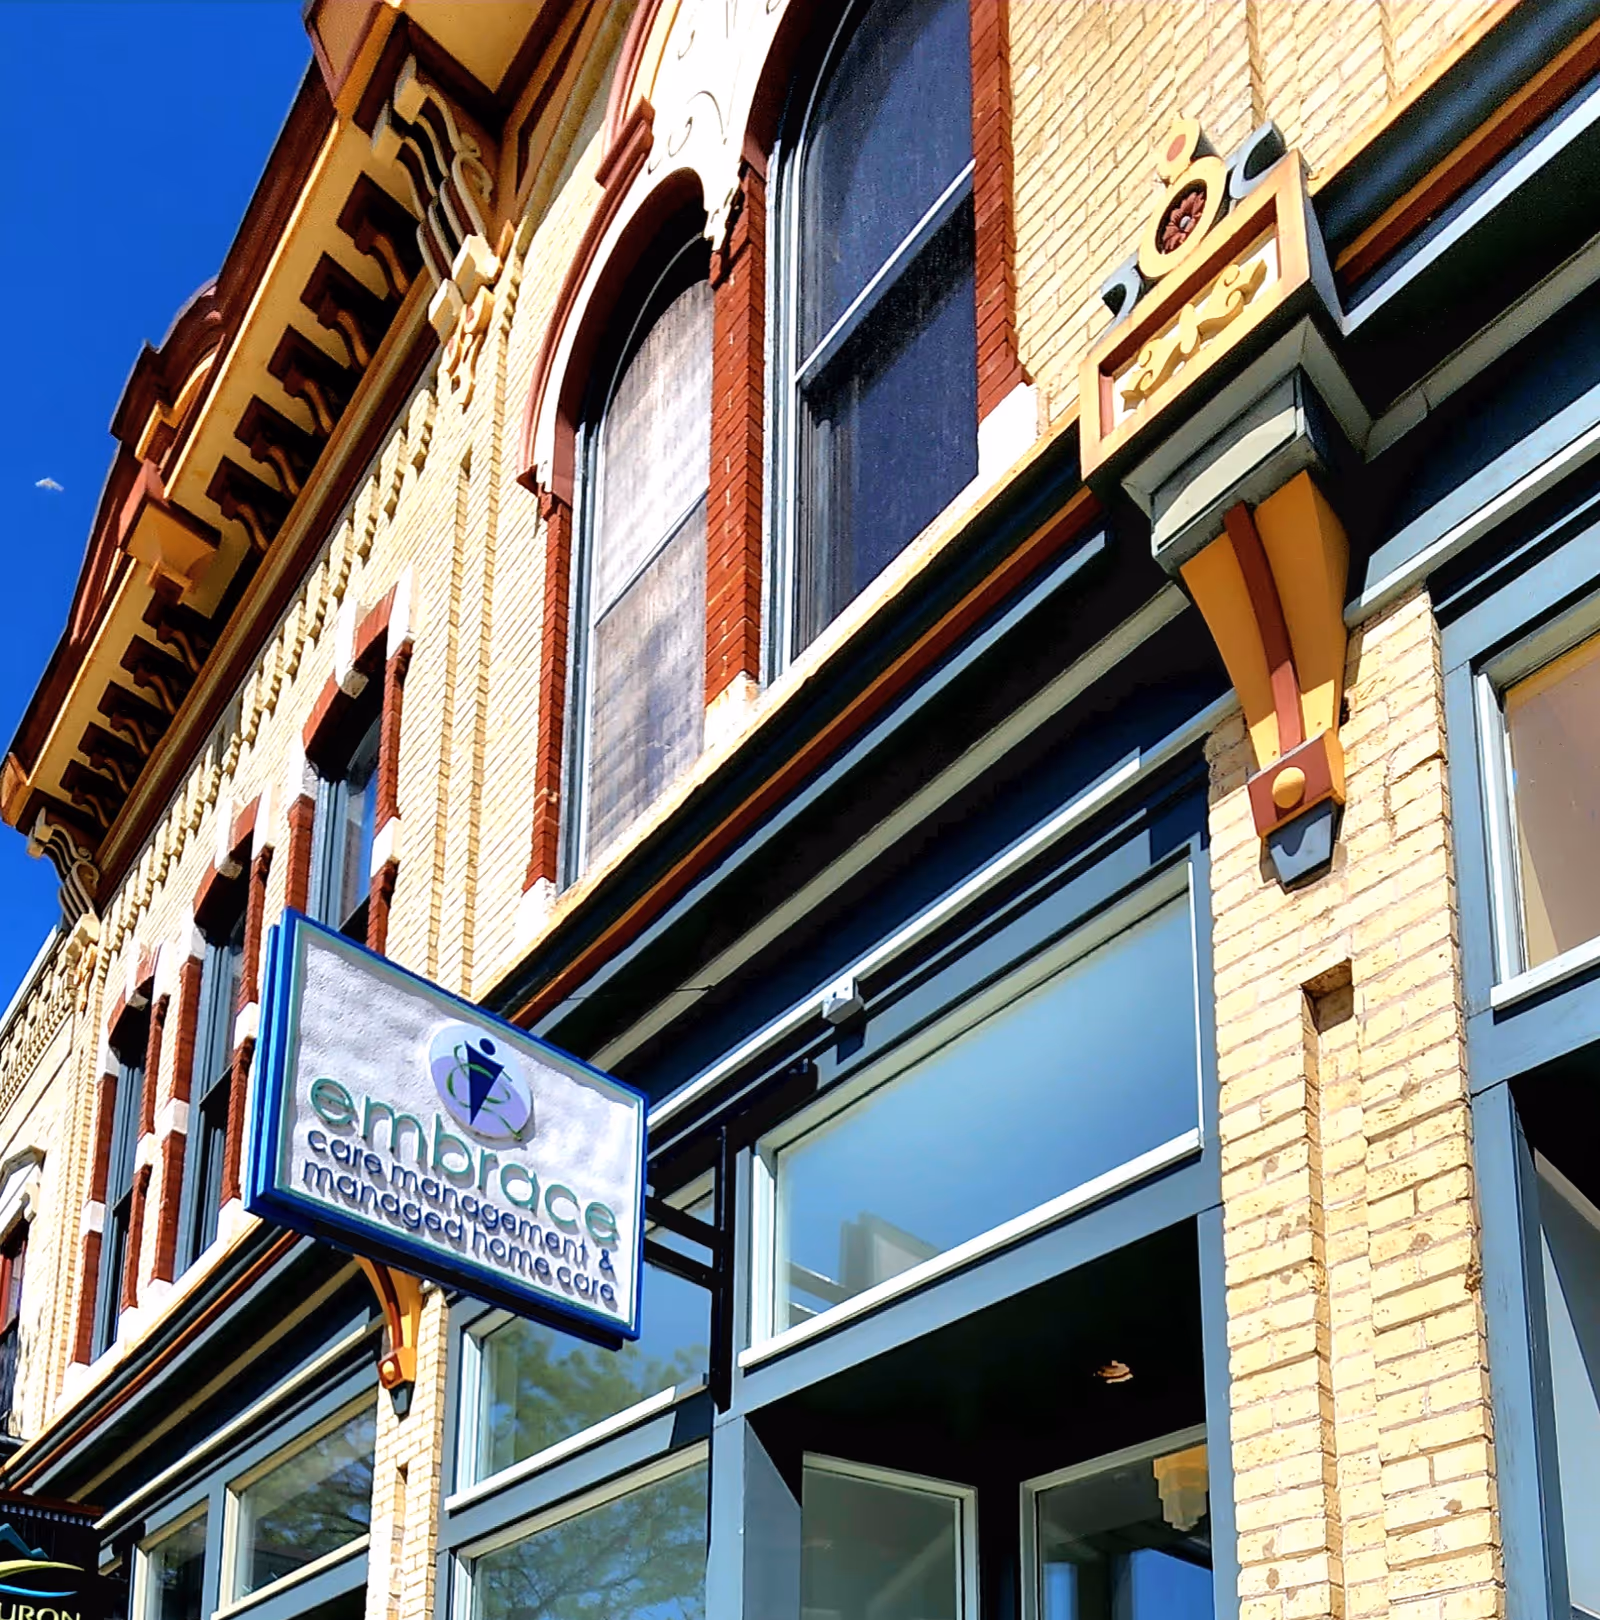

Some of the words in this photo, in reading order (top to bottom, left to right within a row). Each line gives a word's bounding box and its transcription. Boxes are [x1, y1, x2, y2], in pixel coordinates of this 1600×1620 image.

[303, 1159, 464, 1242] managed
[472, 1220, 550, 1277] home
[557, 1266, 615, 1303] care
[307, 1130, 382, 1174] care
[390, 1162, 587, 1264] management
[599, 1250, 615, 1274] &
[309, 1078, 618, 1243] embrace
